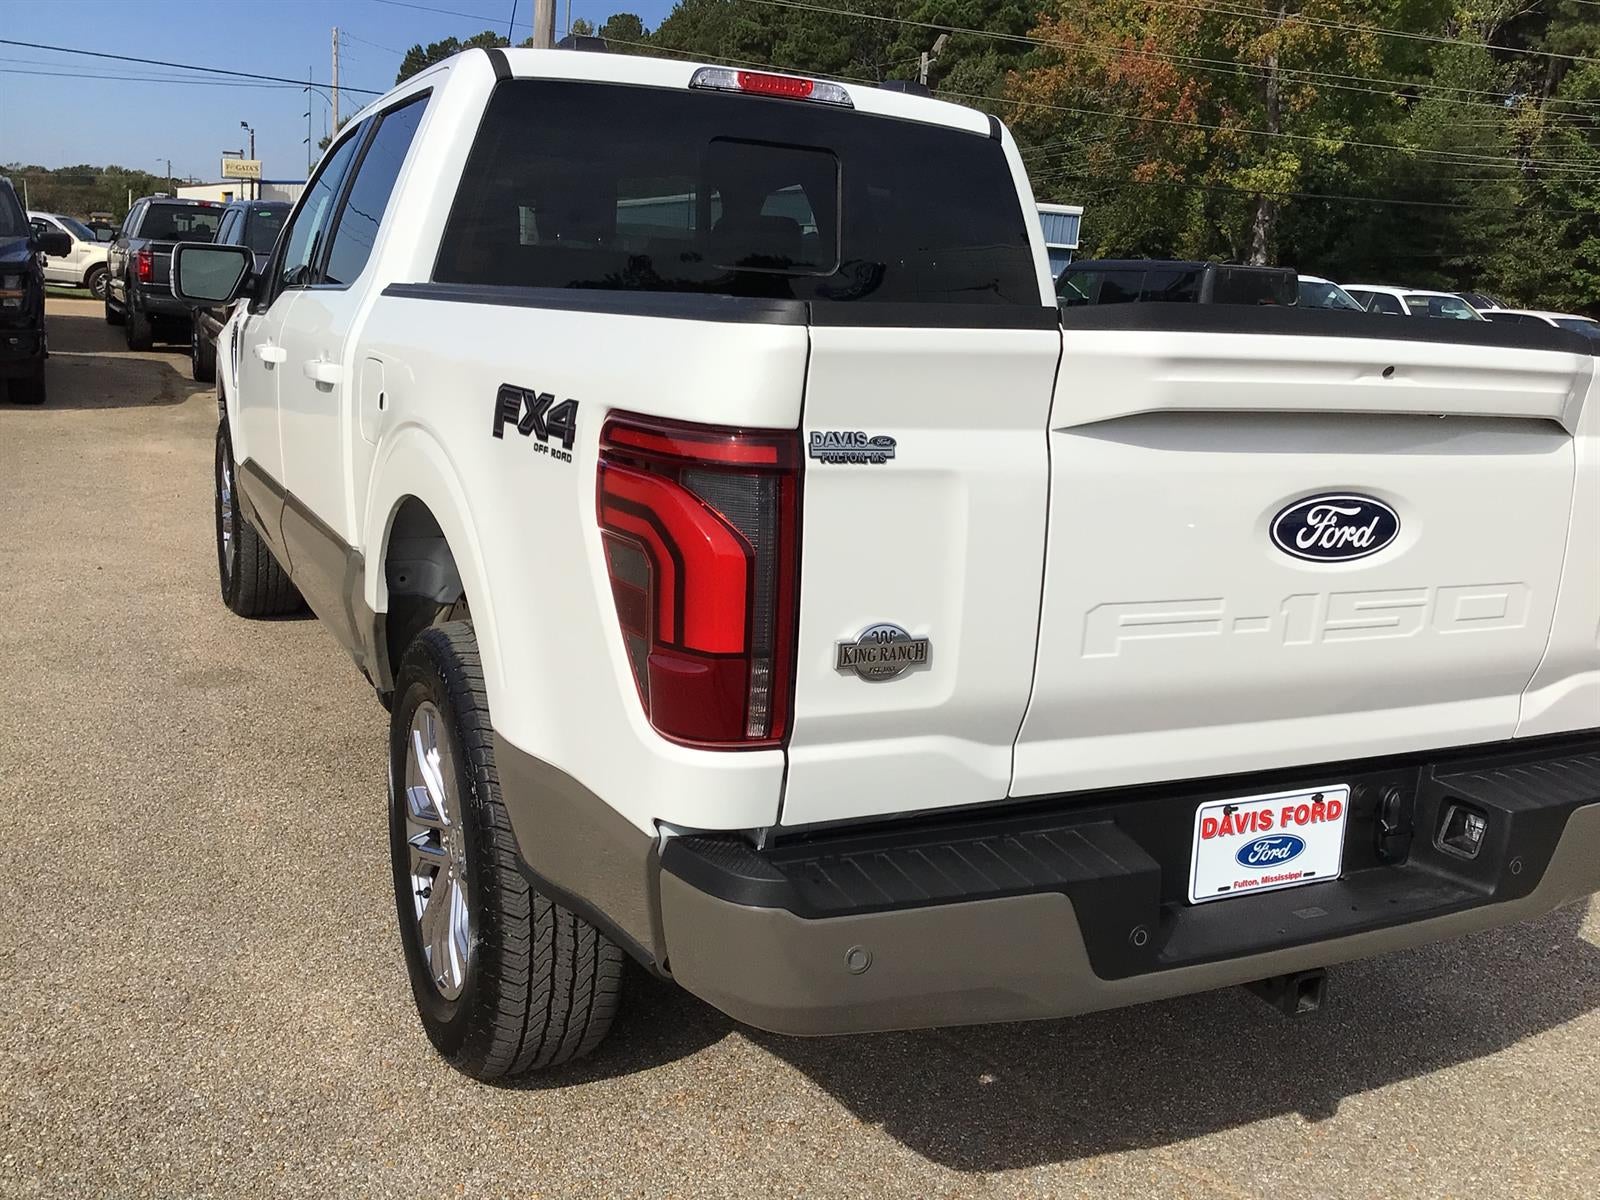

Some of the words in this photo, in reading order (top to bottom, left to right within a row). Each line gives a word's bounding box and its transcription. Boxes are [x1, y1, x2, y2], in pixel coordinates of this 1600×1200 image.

[493, 382, 579, 451] FX4
[811, 431, 868, 448] DAVIS
[533, 442, 549, 455] OFF
[550, 447, 572, 464] ROAD
[1296, 505, 1380, 549] Ford
[1080, 581, 1533, 659] F-150
[842, 646, 877, 665] KING
[879, 642, 924, 662] RANCH
[1201, 809, 1275, 840] DAVIS
[1280, 799, 1343, 828] FORD
[1247, 838, 1293, 864] Ford
[1233, 878, 1260, 889] Fulton,
[1261, 870, 1302, 884] Mississippi
